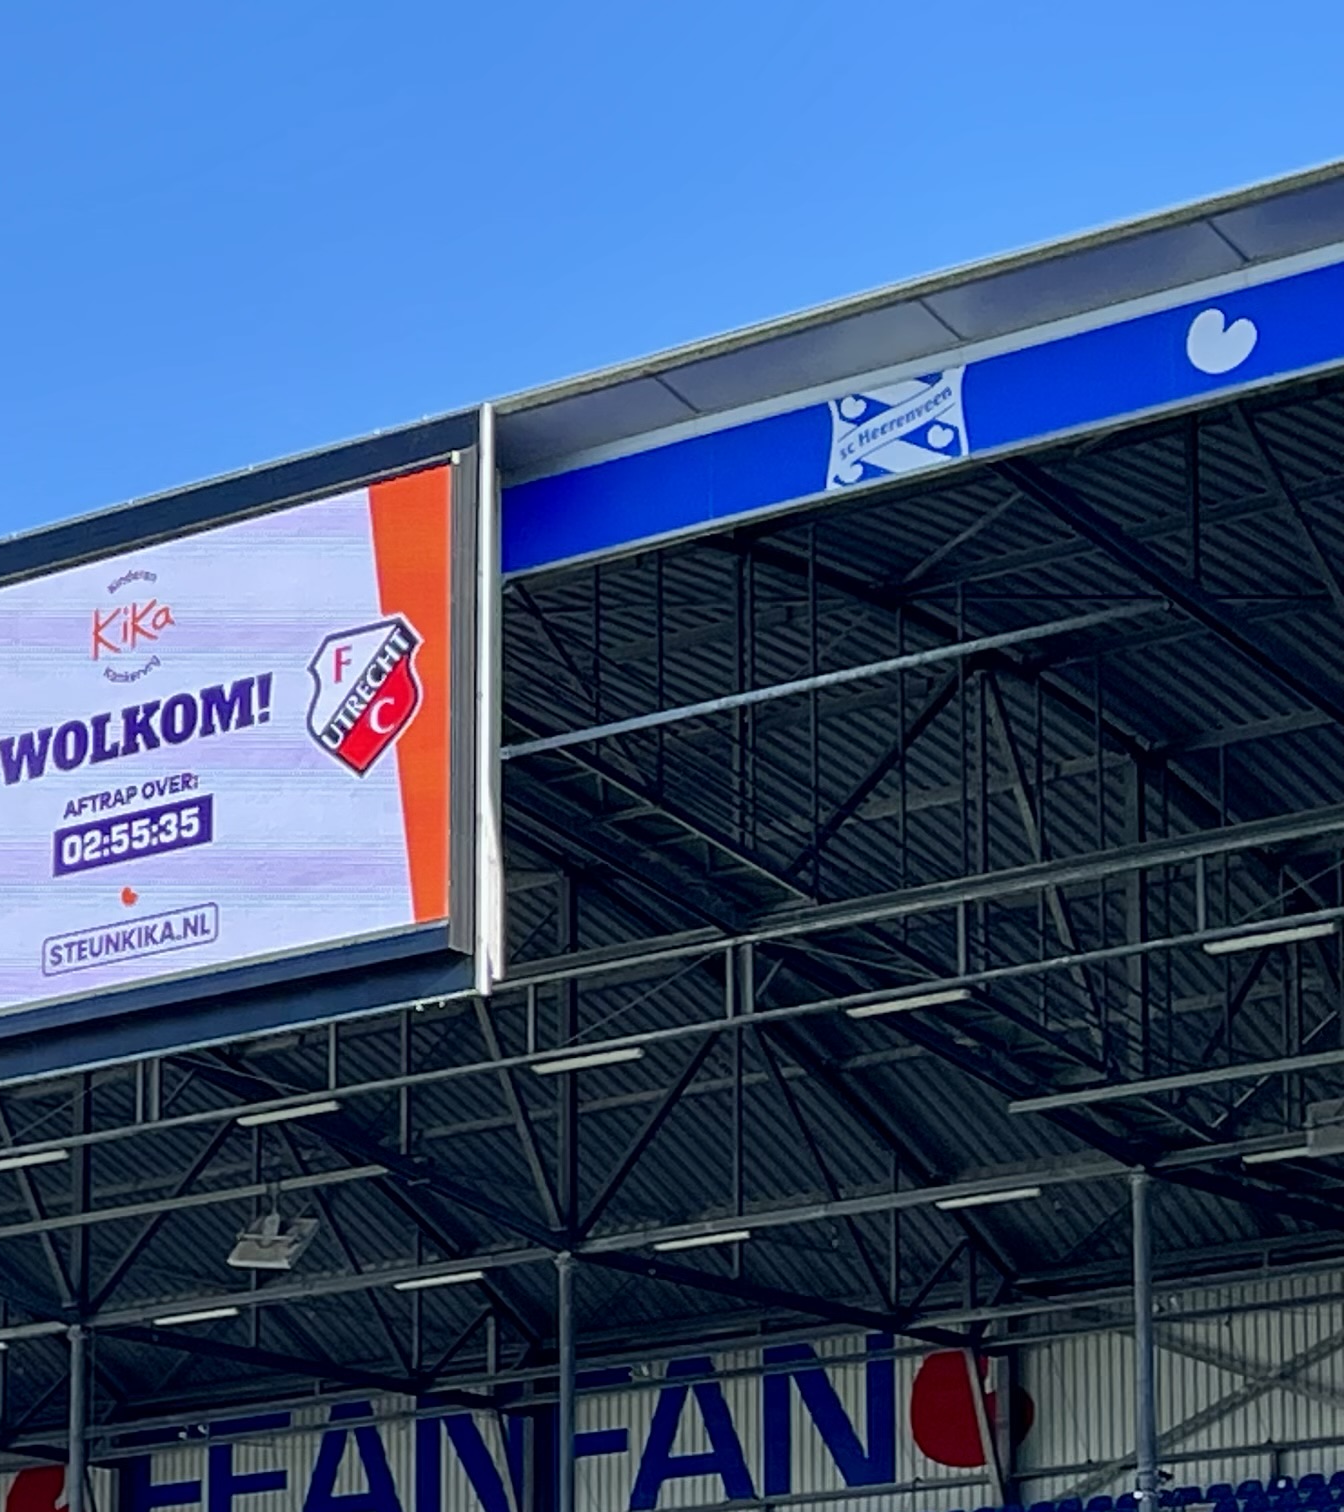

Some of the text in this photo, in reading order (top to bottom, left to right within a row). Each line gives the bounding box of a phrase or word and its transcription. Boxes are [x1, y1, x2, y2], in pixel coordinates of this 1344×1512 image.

[858, 386, 953, 447] Heerenveen
[321, 628, 410, 749] UTRECHT
[334, 644, 353, 684] F
[369, 697, 396, 734] C
[64, 772, 200, 819] AFTRAP OVER:
[62, 806, 201, 866] 02:55:35
[49, 912, 211, 968] STEUNKIKA.NL
